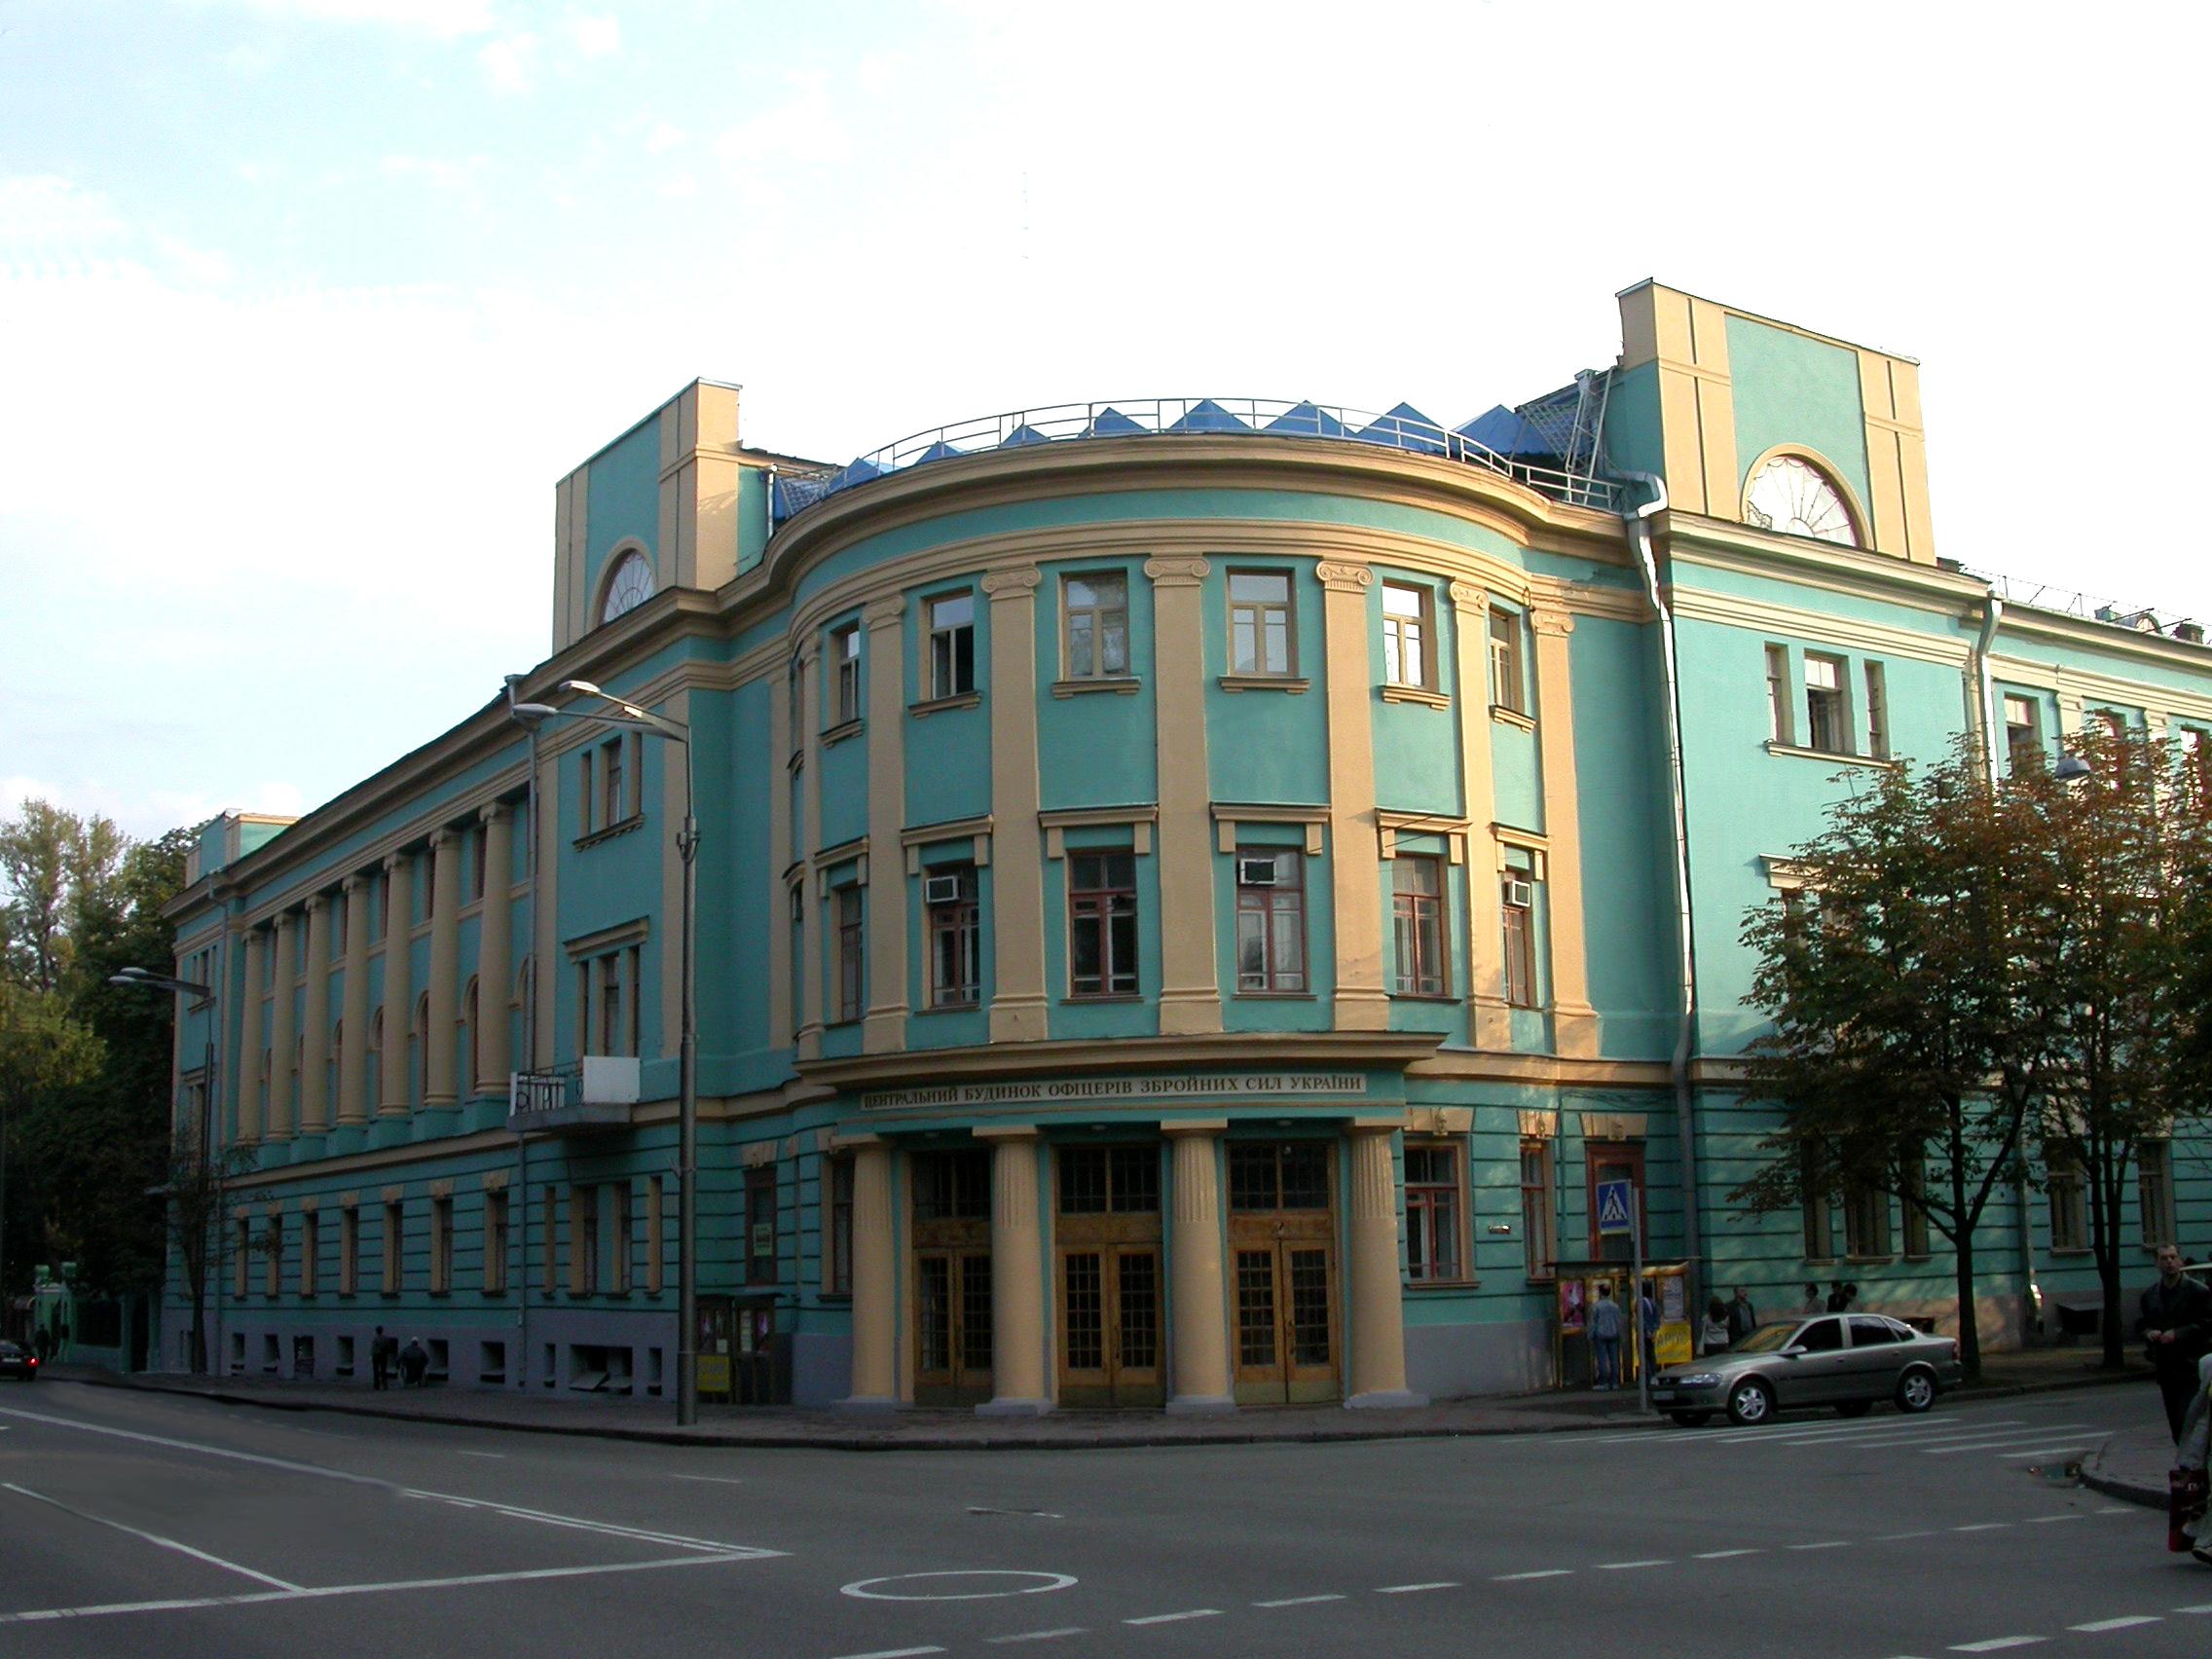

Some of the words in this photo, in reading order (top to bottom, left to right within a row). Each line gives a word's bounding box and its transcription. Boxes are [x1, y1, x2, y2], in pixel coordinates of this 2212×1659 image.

[865, 1088, 958, 1107] ЦЕНТРАЛЬНИЙ
[965, 1085, 1041, 1101] БУДИНОК
[1049, 1082, 1131, 1097] ОФІЦЕРІВ
[1141, 1076, 1238, 1093] ЗБРОЙНИХ
[1246, 1077, 1281, 1089] СИЛ
[1291, 1075, 1361, 1089] УКРАЇНИ
